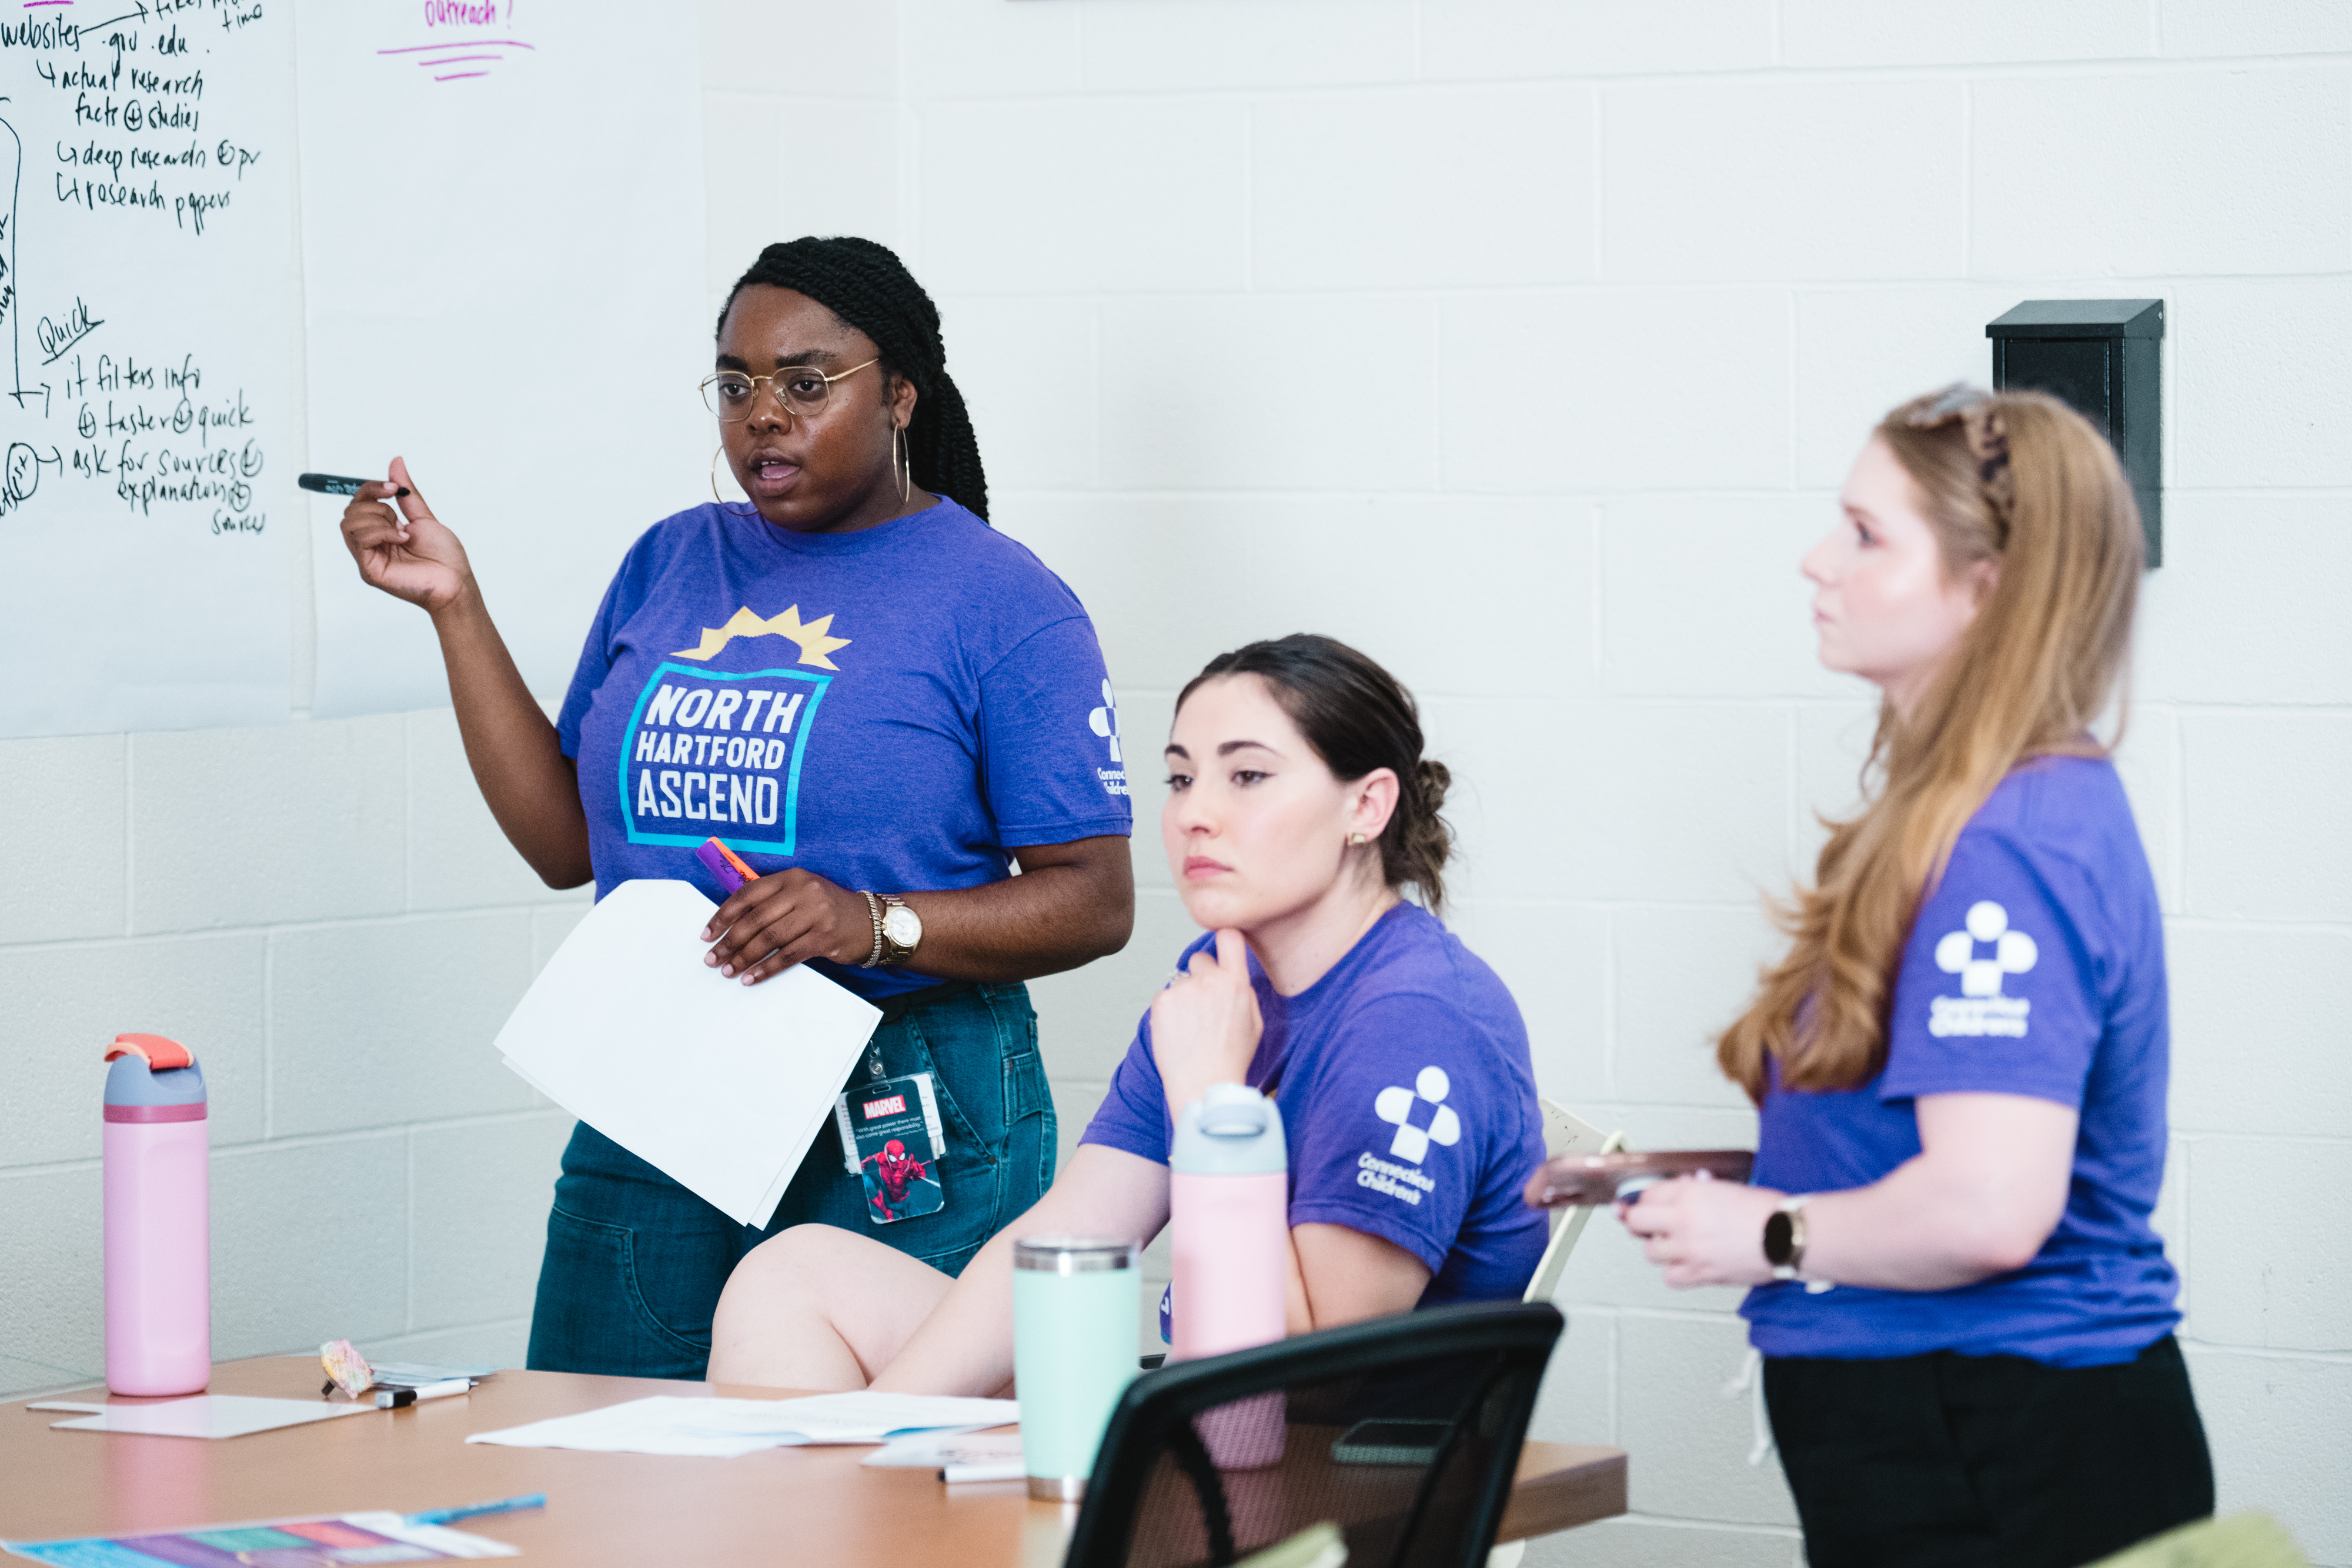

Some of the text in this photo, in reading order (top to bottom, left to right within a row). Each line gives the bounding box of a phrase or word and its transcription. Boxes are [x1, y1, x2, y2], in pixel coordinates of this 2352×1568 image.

[1, 14, 81, 51] websites
[62, 61, 203, 101] actual research
[148, 101, 199, 132] studies
[83, 140, 122, 182] deep
[131, 139, 206, 169] research
[86, 179, 230, 236] research papers
[66, 355, 89, 399] it
[97, 355, 153, 392] filters
[74, 440, 236, 482] ask for sources
[644, 684, 804, 734] NORTH
[636, 731, 785, 770] HARTFORD
[638, 769, 779, 825] ASCEND
[864, 1096, 906, 1119] MARVEL
[882, 1121, 897, 1129] power
[878, 1128, 891, 1136] great
